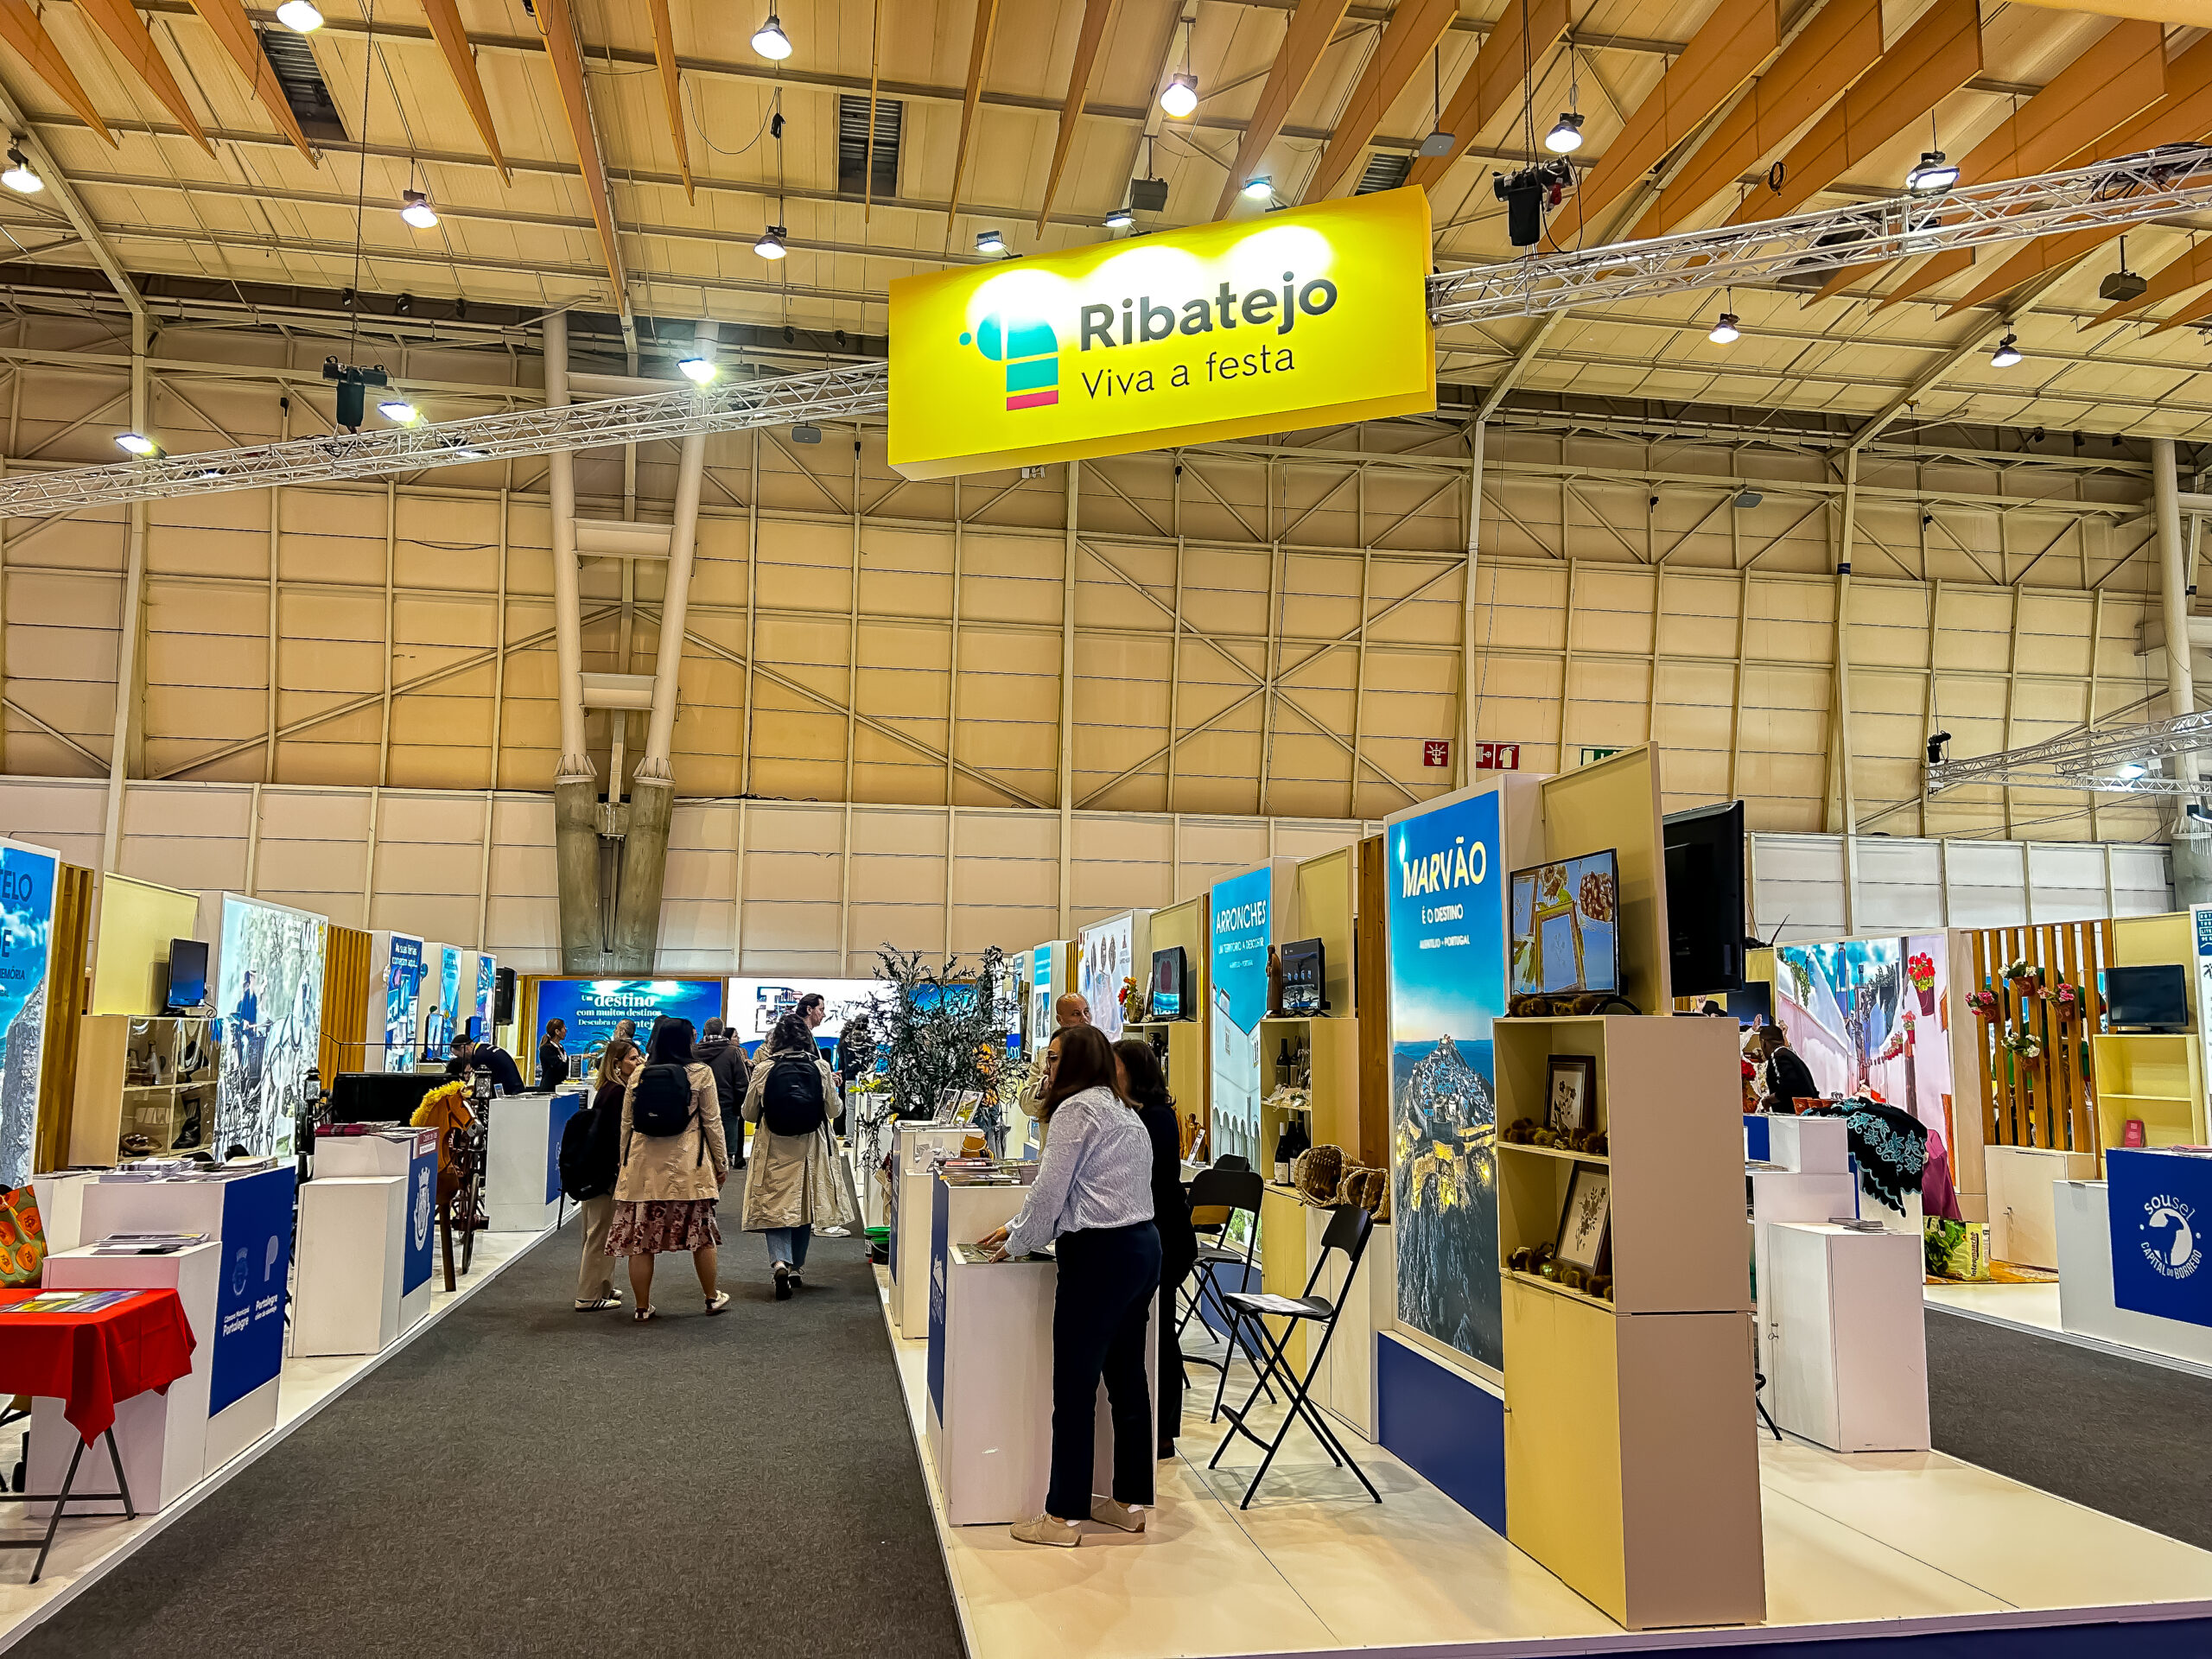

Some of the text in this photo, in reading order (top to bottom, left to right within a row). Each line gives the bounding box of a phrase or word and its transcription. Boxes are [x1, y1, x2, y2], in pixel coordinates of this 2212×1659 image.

[1081, 271, 1338, 352] Ribatejo
[1081, 345, 1294, 400] Viva a festa
[1402, 836, 1487, 898] MARVÃO
[1216, 899, 1267, 934] ARRONCHES
[1421, 904, 1464, 925] É O DESTINO
[0, 965, 25, 980] EMÓRIA
[594, 992, 655, 1007] destino
[596, 1008, 626, 1017] muitos
[626, 1008, 662, 1017] destinos
[2141, 1242, 2202, 1279] CAPITAL DO BORREGO
[223, 1316, 250, 1337] Portalegre
